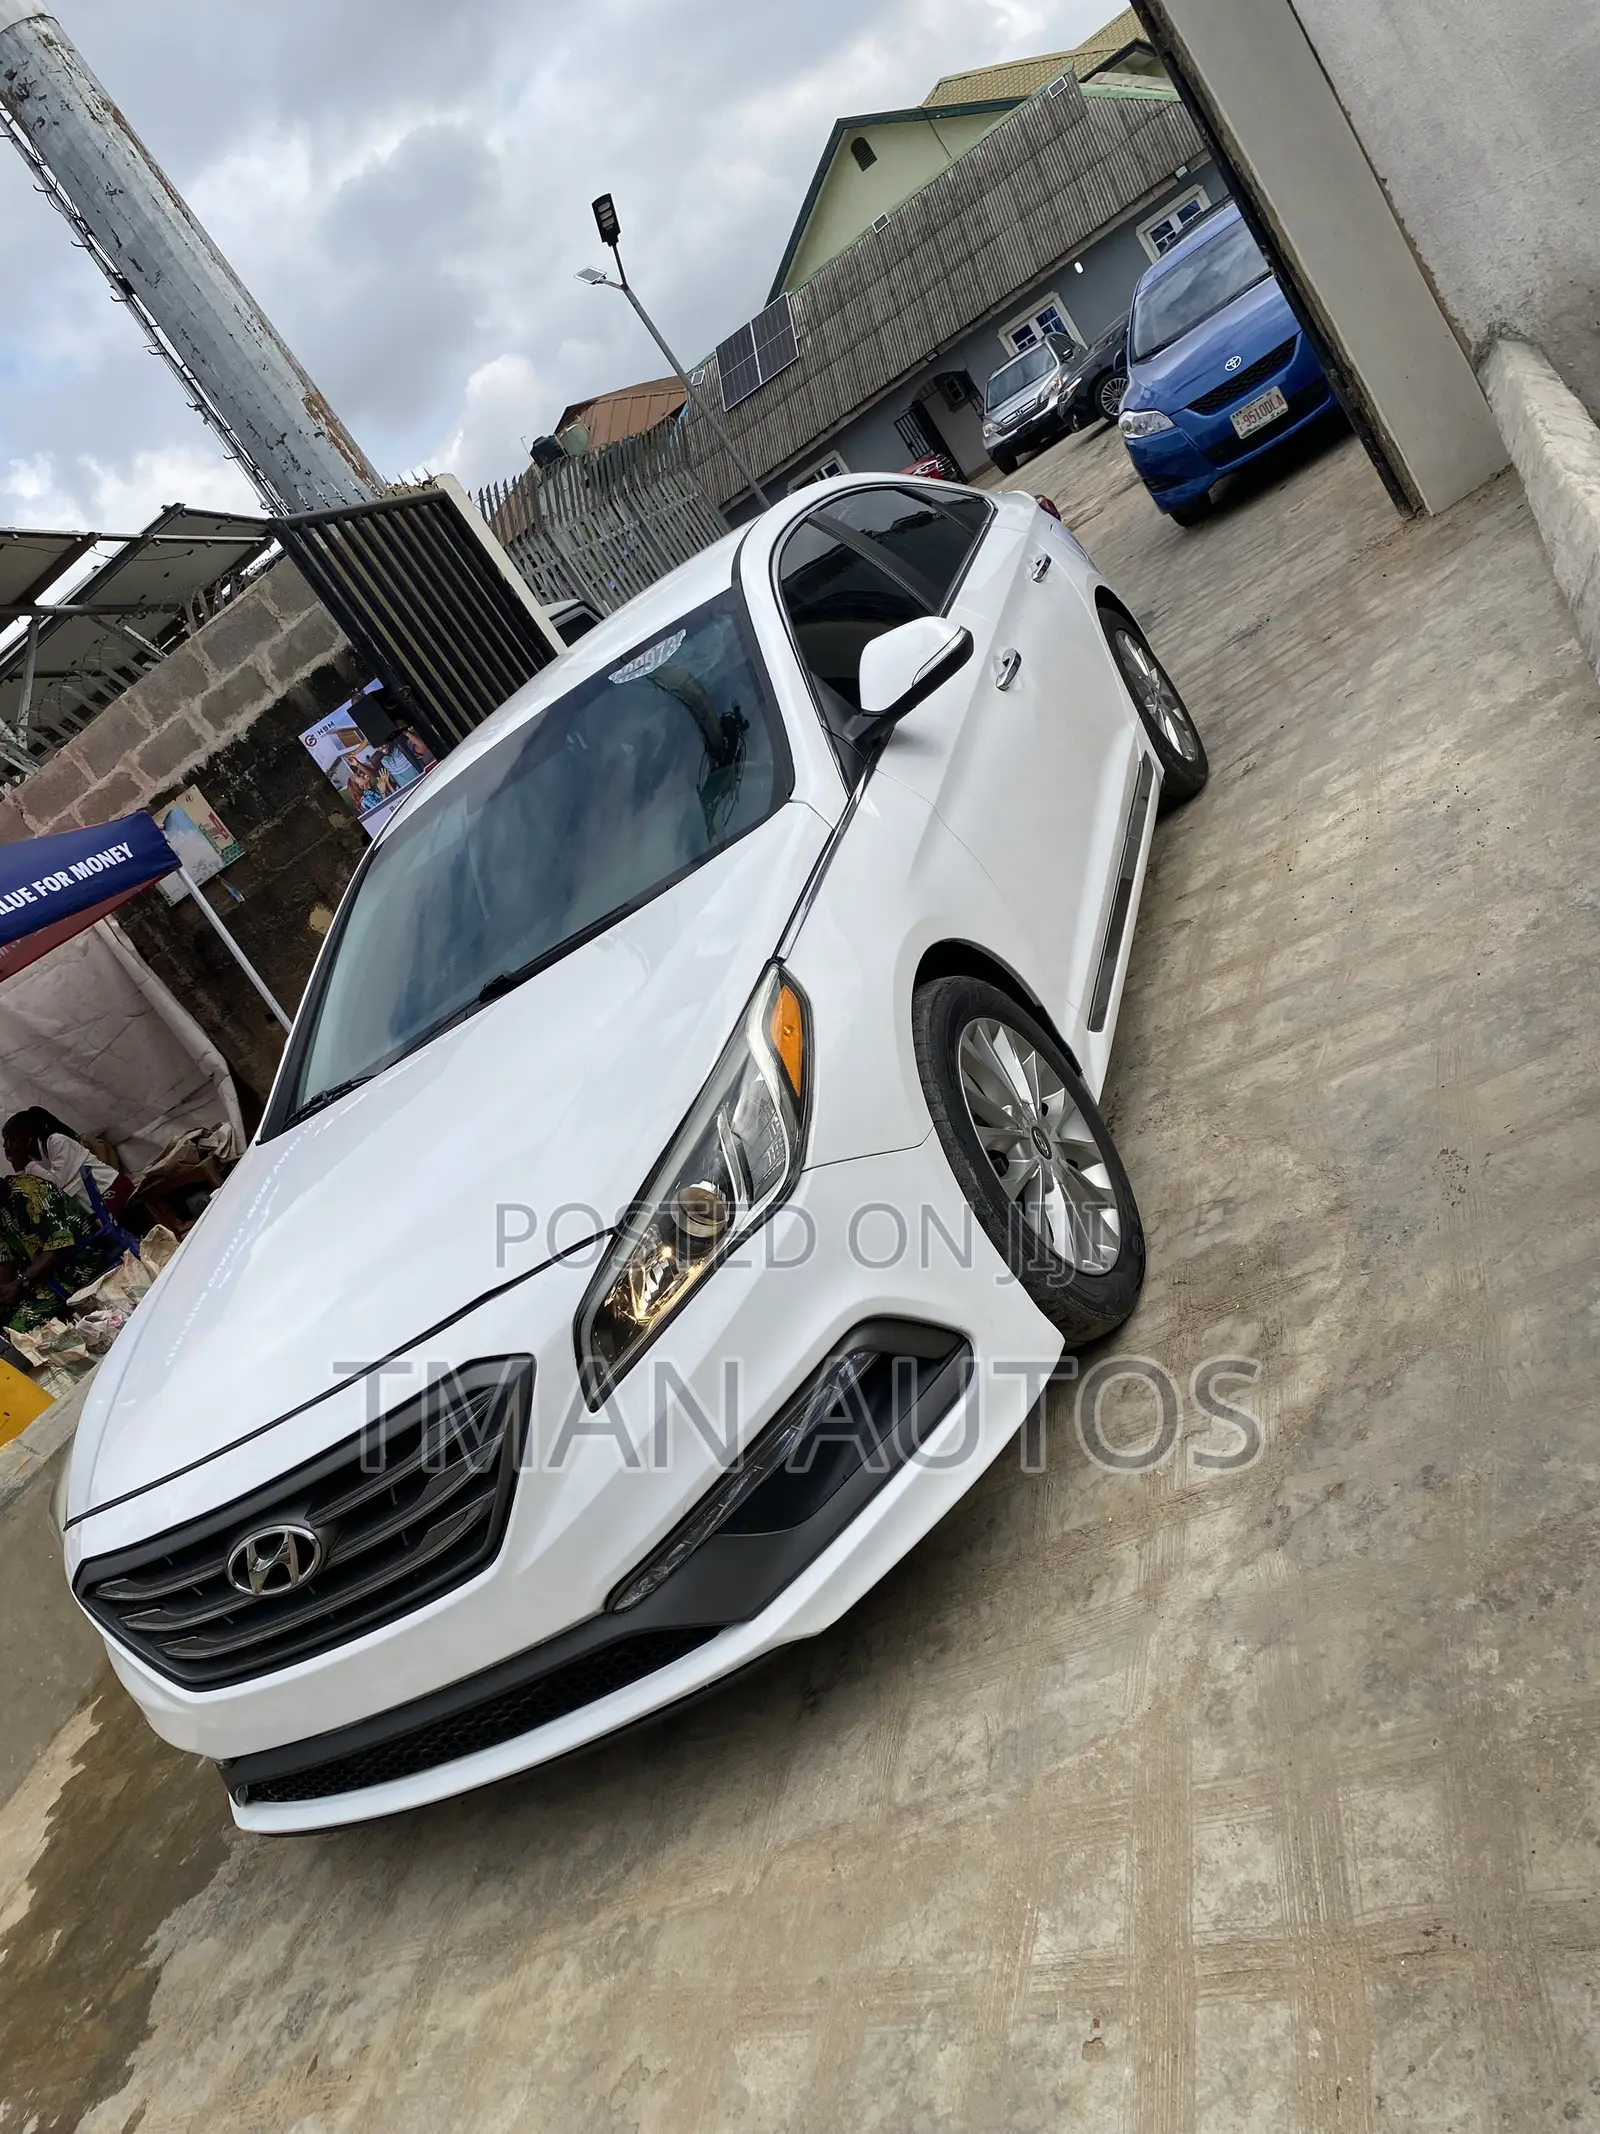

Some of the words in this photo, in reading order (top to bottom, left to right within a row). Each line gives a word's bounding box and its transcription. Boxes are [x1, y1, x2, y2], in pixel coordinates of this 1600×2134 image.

[316, 721, 336, 737] HBM
[0, 886, 39, 916] LUE
[31, 871, 76, 897] FOR
[68, 841, 134, 881] MONEY
